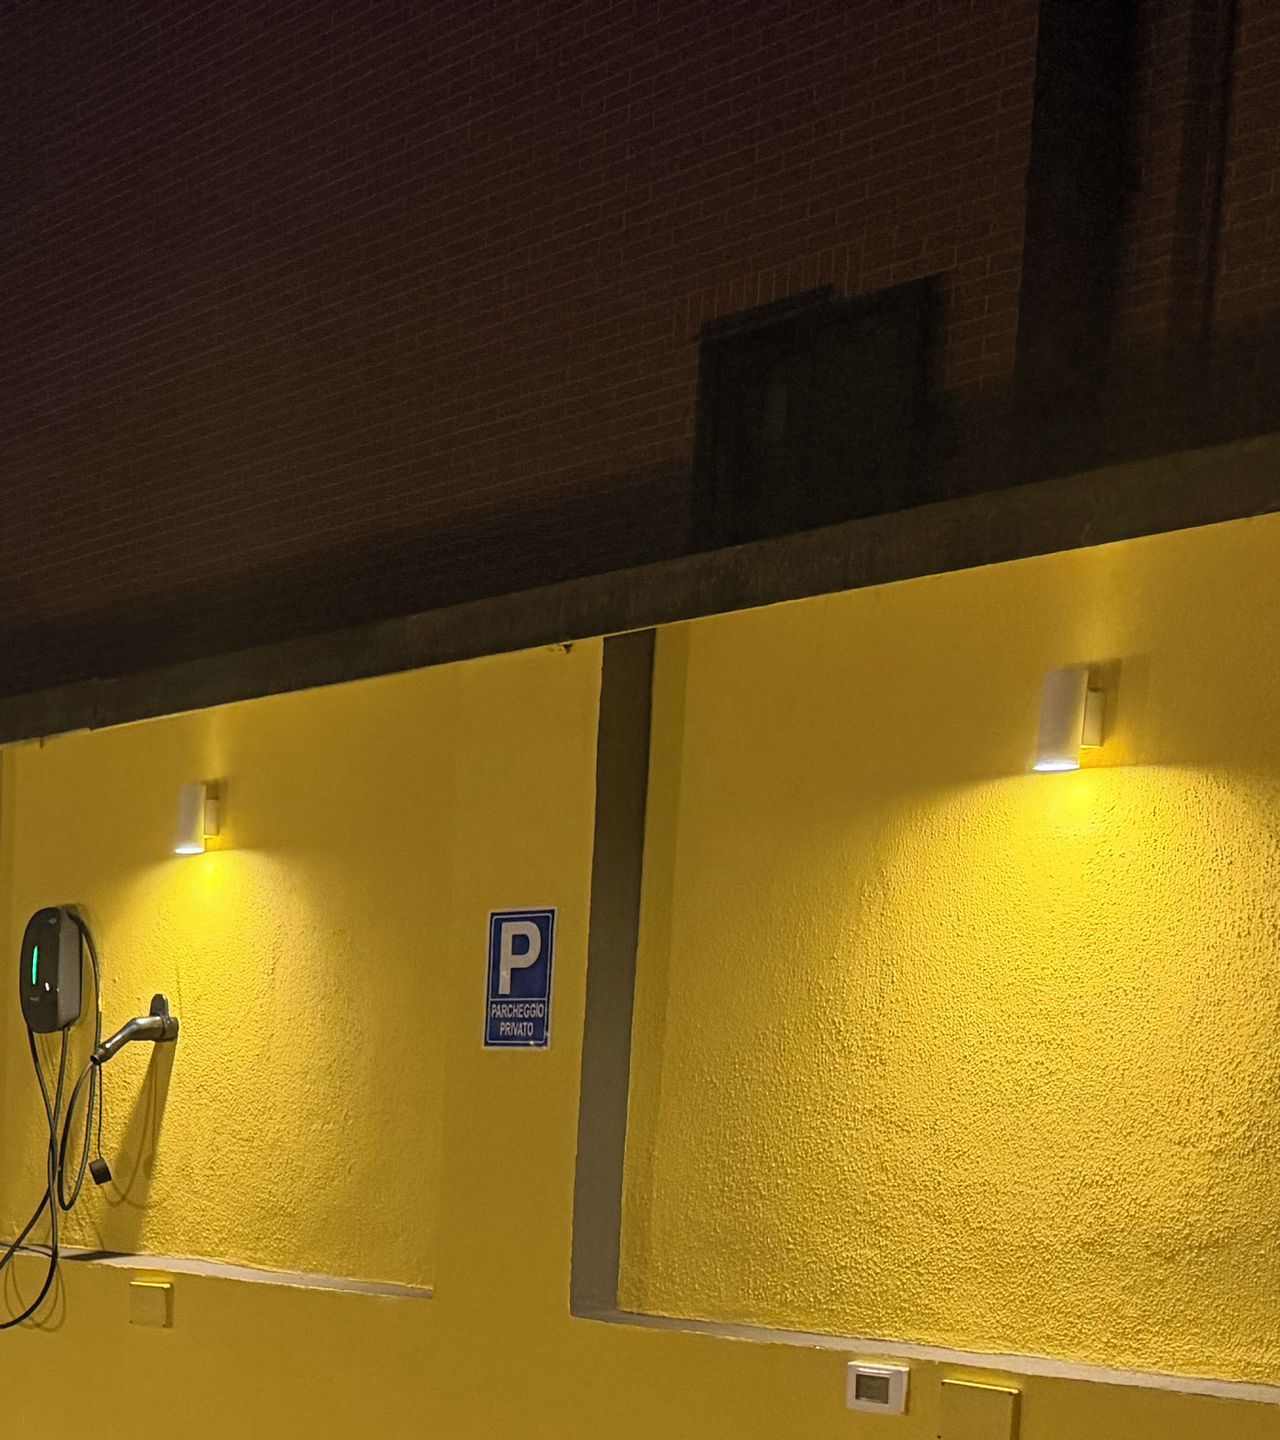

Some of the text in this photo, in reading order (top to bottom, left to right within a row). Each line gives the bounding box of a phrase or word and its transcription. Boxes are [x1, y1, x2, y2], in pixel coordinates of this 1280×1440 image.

[498, 921, 541, 995] P
[491, 1003, 544, 1018] PARCHEGGIO
[500, 1021, 533, 1036] PRIVATO
